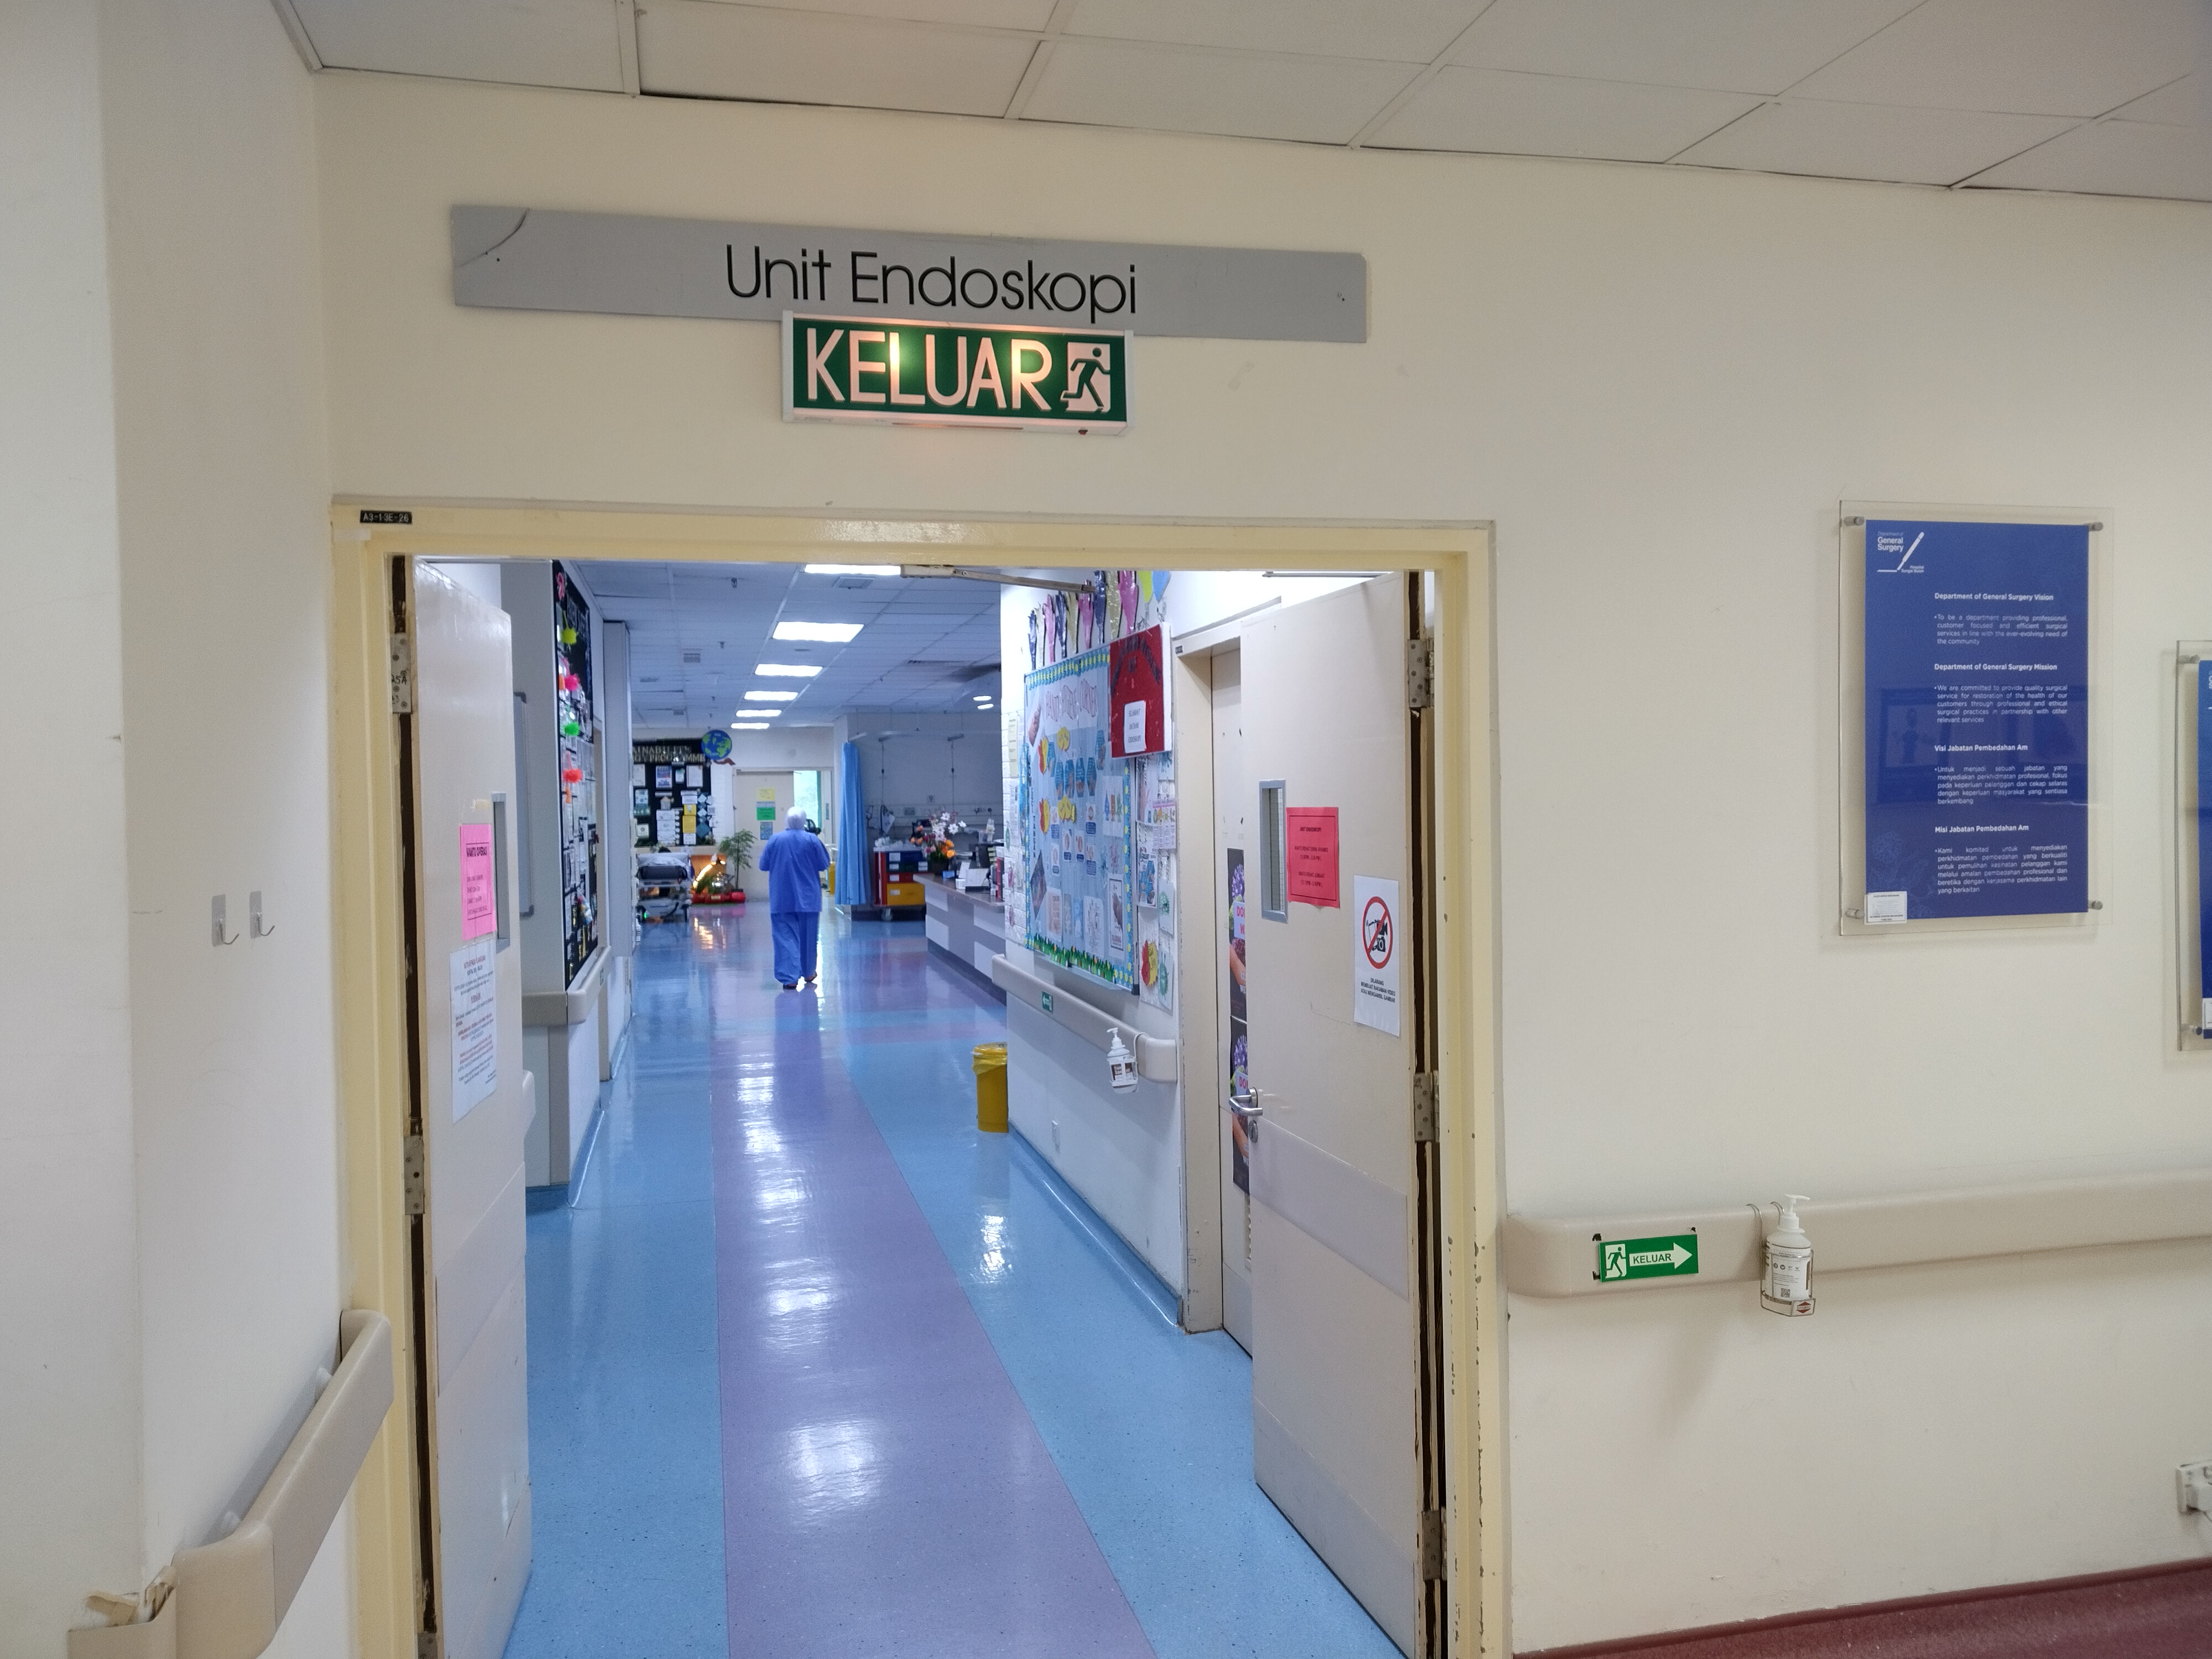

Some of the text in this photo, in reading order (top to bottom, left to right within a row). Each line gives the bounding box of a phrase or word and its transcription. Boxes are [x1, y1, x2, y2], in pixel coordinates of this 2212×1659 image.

[726, 244, 1136, 324] Unit Endoskopi
[806, 327, 1052, 411] KELUAR
[1877, 544, 1903, 552] Surgery
[1934, 592, 1973, 601] Department
[2032, 614, 2068, 623] professional,
[2018, 772, 2050, 780] profesional,
[2031, 844, 2068, 852] menyediakan
[2023, 868, 2054, 876] profesional
[1964, 877, 1985, 885] dengan
[1370, 977, 1384, 986] DILARANG
[1374, 985, 1387, 994] RAKAMAN
[1384, 994, 1396, 1003] GAMBAR
[1632, 1253, 1672, 1265] KELUAR
